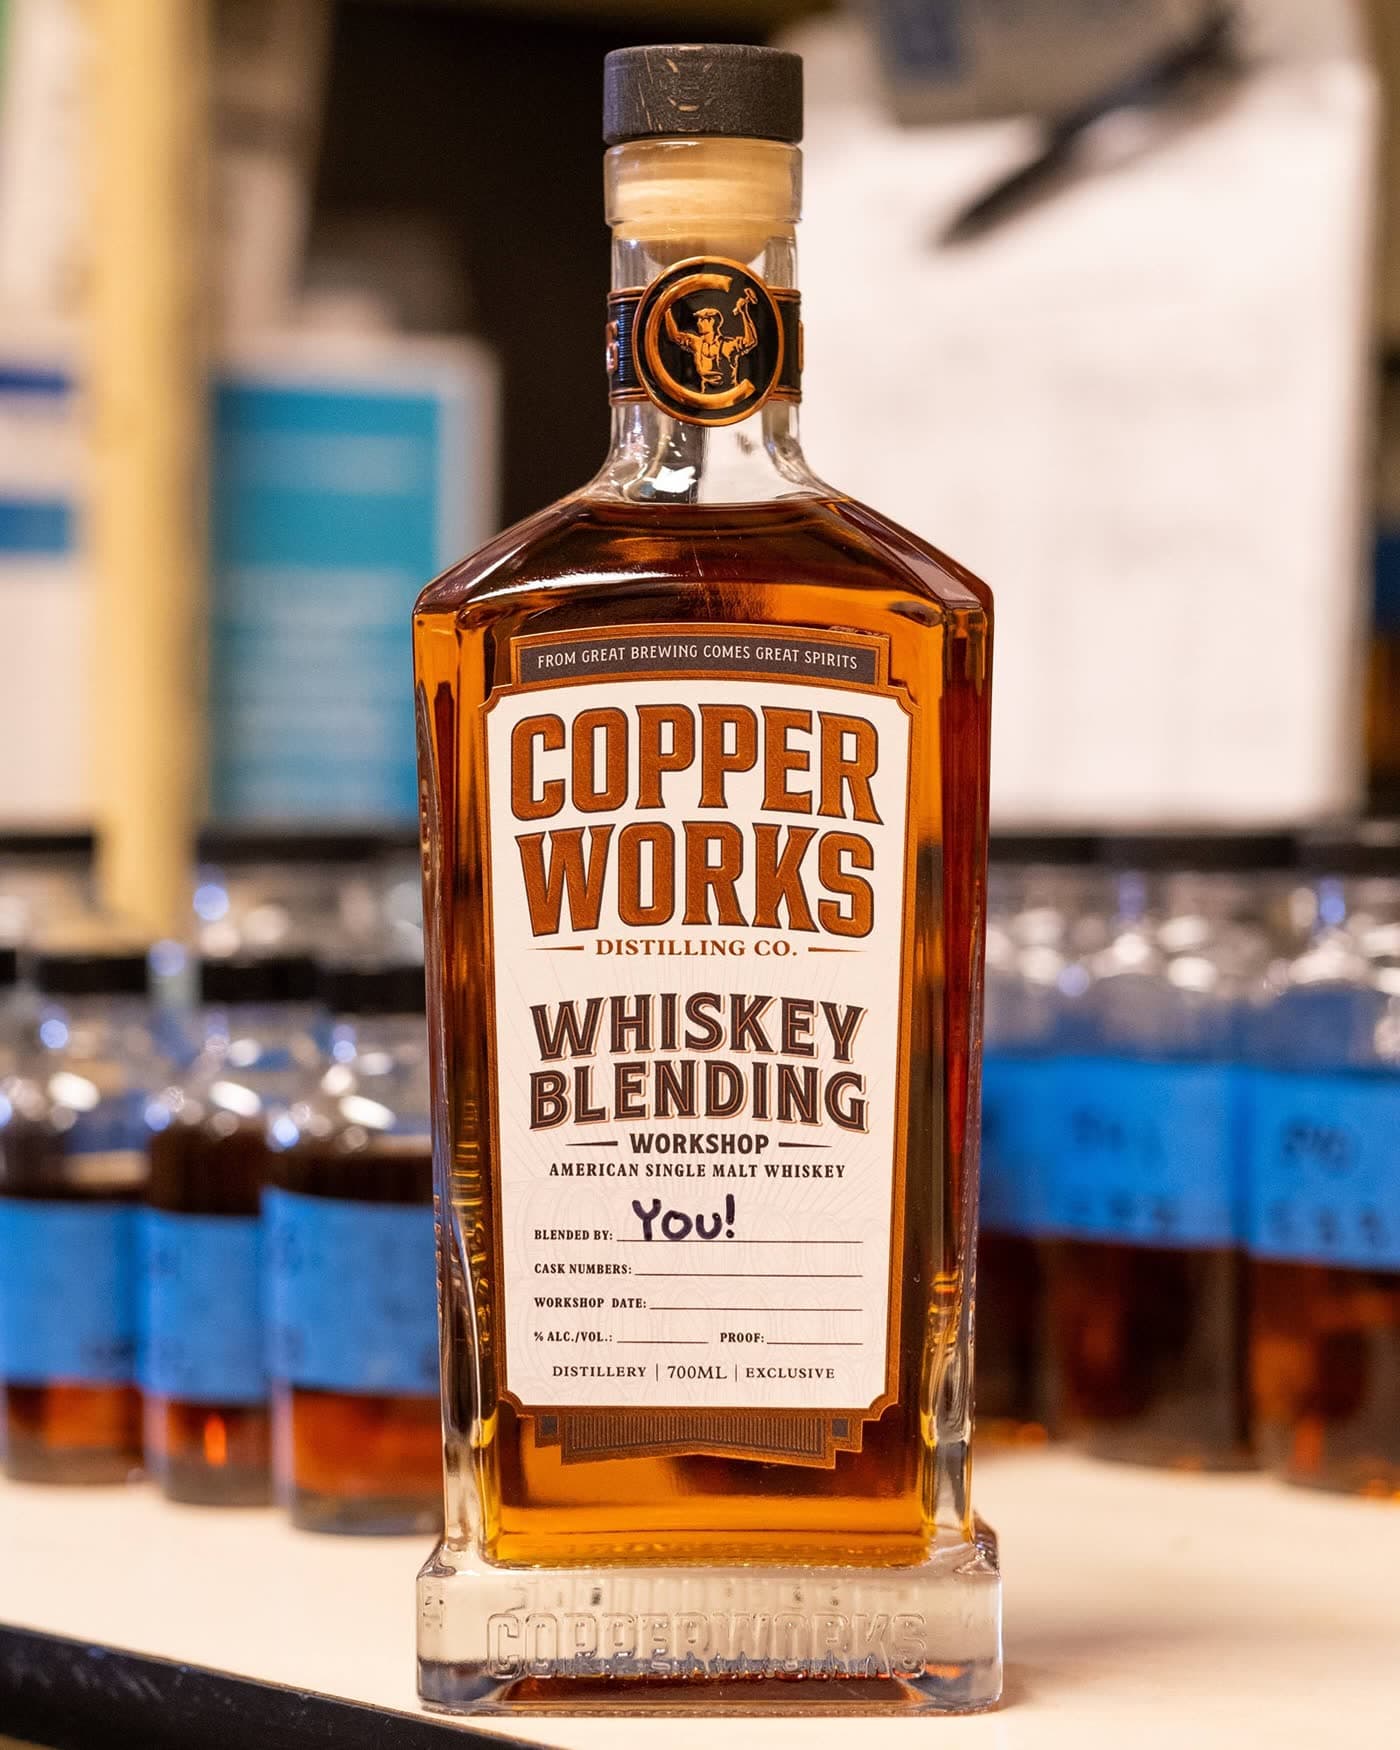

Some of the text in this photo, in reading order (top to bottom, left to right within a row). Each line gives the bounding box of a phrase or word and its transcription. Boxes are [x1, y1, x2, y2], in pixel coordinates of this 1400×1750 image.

[538, 645, 857, 669] FROM GREAT BREWING COMES GREAT SPIRITS
[511, 703, 884, 826] COPPER
[515, 821, 874, 938] WORKS
[595, 939, 797, 956] DISTILLING CO.
[529, 992, 867, 1063] WHISKEY
[529, 1060, 869, 1134] BLENDING
[630, 1133, 770, 1154] WORKSHOP
[549, 1163, 845, 1178] AMERICAN SINGLE MALT WHISKEY
[534, 1229, 613, 1241] BLENDED BY:
[534, 1263, 632, 1275] CASK NUMBERS:
[534, 1297, 647, 1309] WORKSHOP DATE:
[534, 1331, 613, 1343] % ALC./VOL.:
[720, 1332, 765, 1343] PROOF:
[552, 1365, 835, 1380] DISTILLERY 700ML EXCLUSIVE
[487, 1612, 927, 1680] COPPERWORKS
